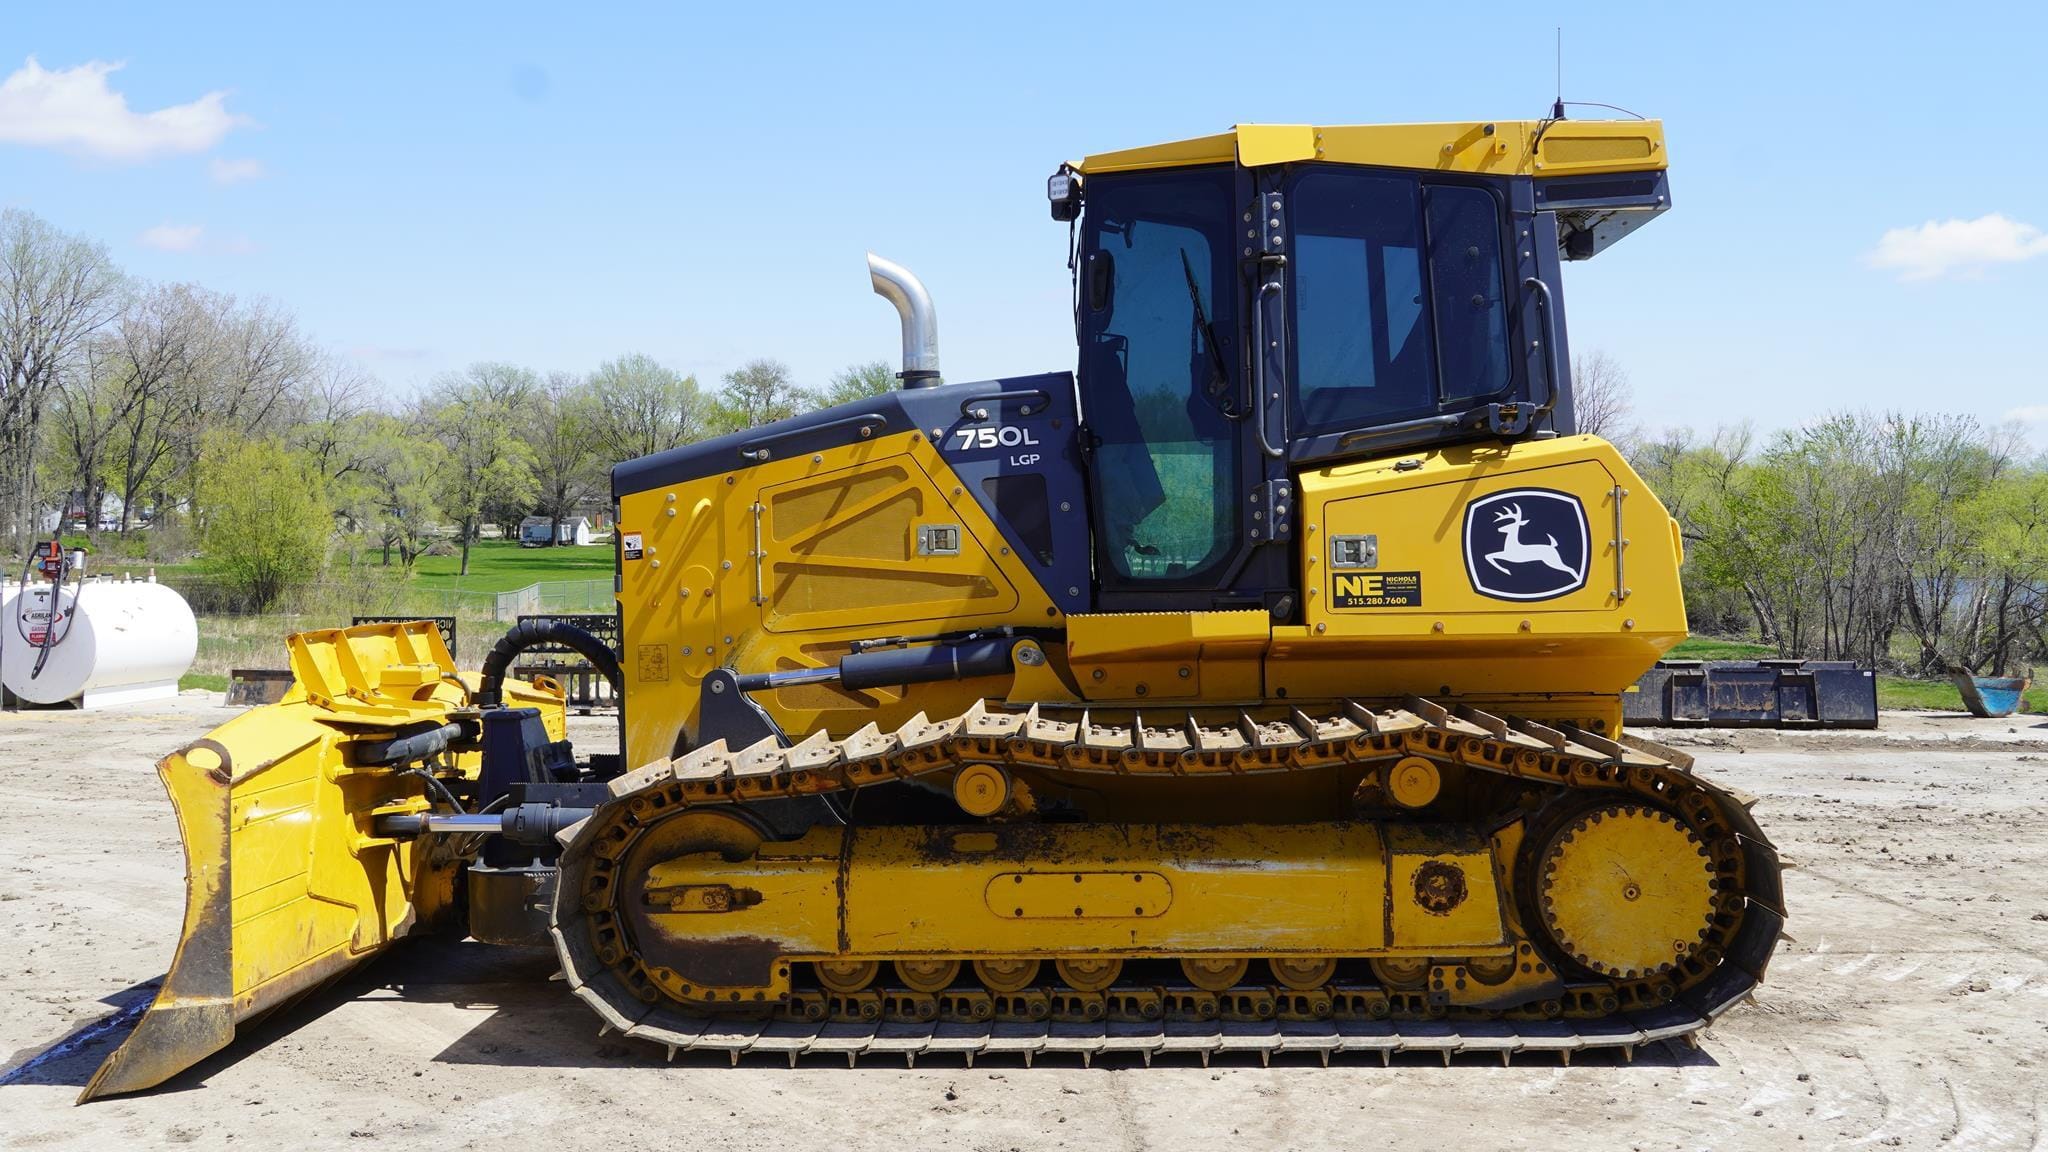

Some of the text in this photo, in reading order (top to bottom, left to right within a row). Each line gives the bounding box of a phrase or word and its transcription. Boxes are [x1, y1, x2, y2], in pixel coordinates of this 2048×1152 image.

[956, 426, 1039, 451] 750L
[1010, 454, 1040, 466] LGP
[1336, 575, 1384, 596] NE
[1347, 597, 1407, 605] 515.280.7600
